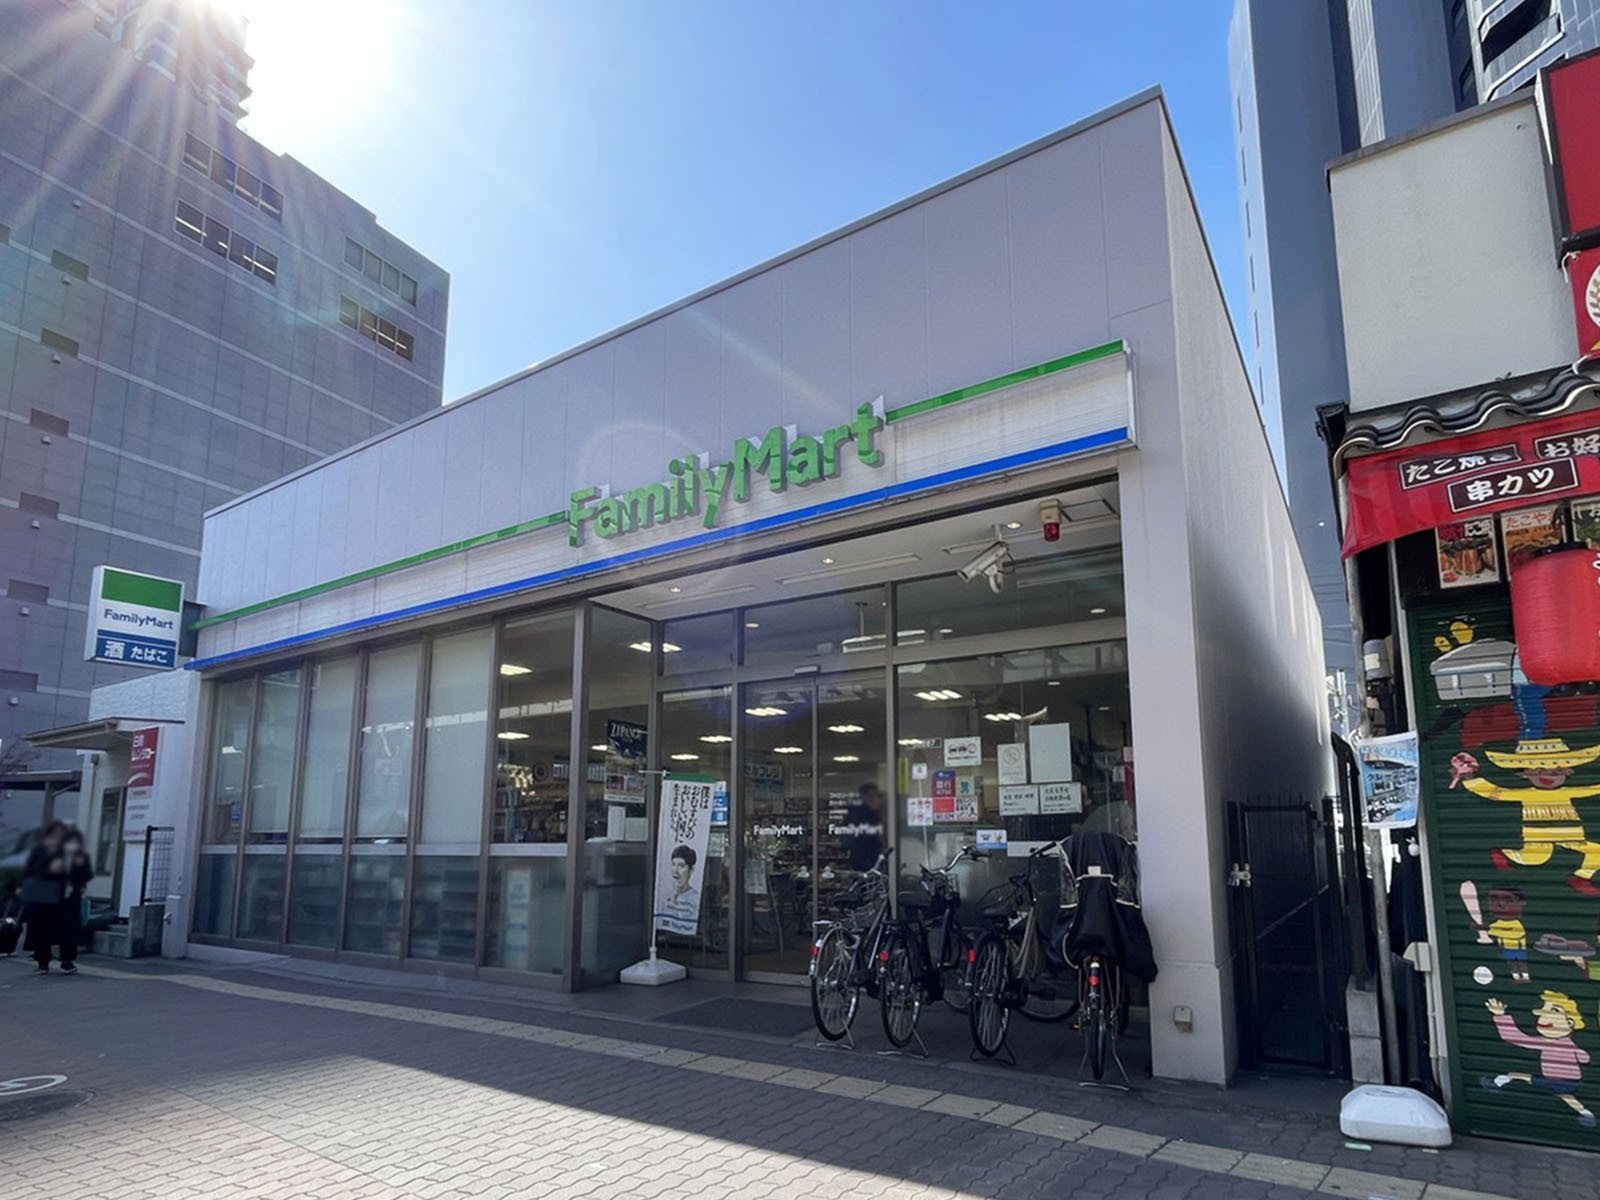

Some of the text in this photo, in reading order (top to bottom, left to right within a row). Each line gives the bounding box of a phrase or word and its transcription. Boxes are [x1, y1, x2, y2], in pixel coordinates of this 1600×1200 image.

[569, 402, 885, 547] FamilyMart
[1466, 467, 1554, 501] 串カツ
[1506, 510, 1554, 529] たこや
[104, 608, 174, 630] FamilyMart
[104, 640, 168, 664] 酒 たばこ
[753, 824, 803, 838] FamilyMart
